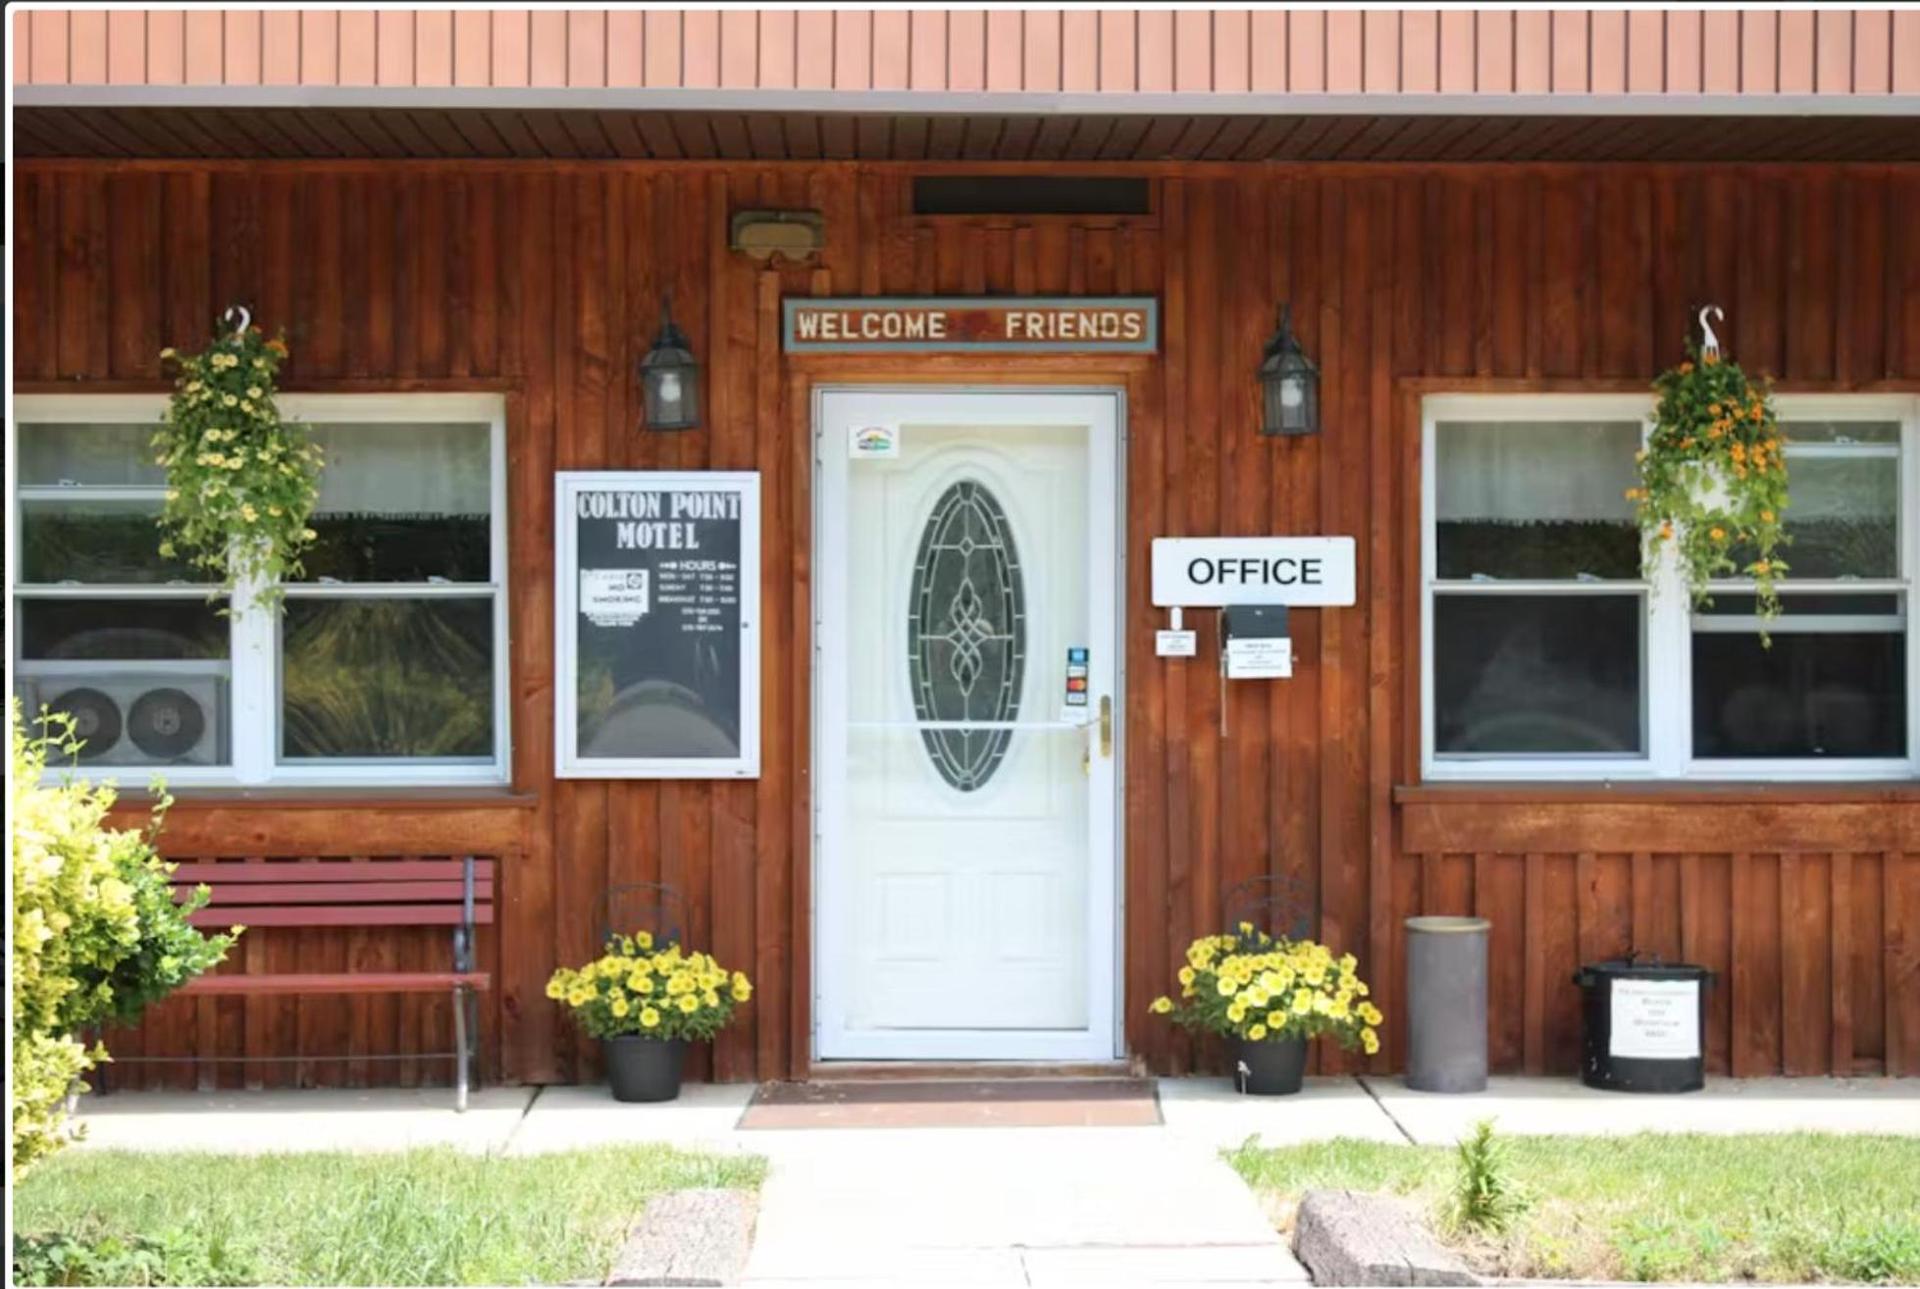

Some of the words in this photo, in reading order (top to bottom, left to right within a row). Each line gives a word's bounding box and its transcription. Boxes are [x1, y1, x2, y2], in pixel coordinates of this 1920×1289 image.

[799, 312, 946, 339] WELCOME
[1005, 312, 1141, 339] FRIENDS
[578, 492, 661, 519] COLTON
[671, 492, 741, 520] POINT
[616, 522, 700, 549] MOTEL
[679, 560, 717, 571] HOURS
[1187, 557, 1323, 585] OFFICE
